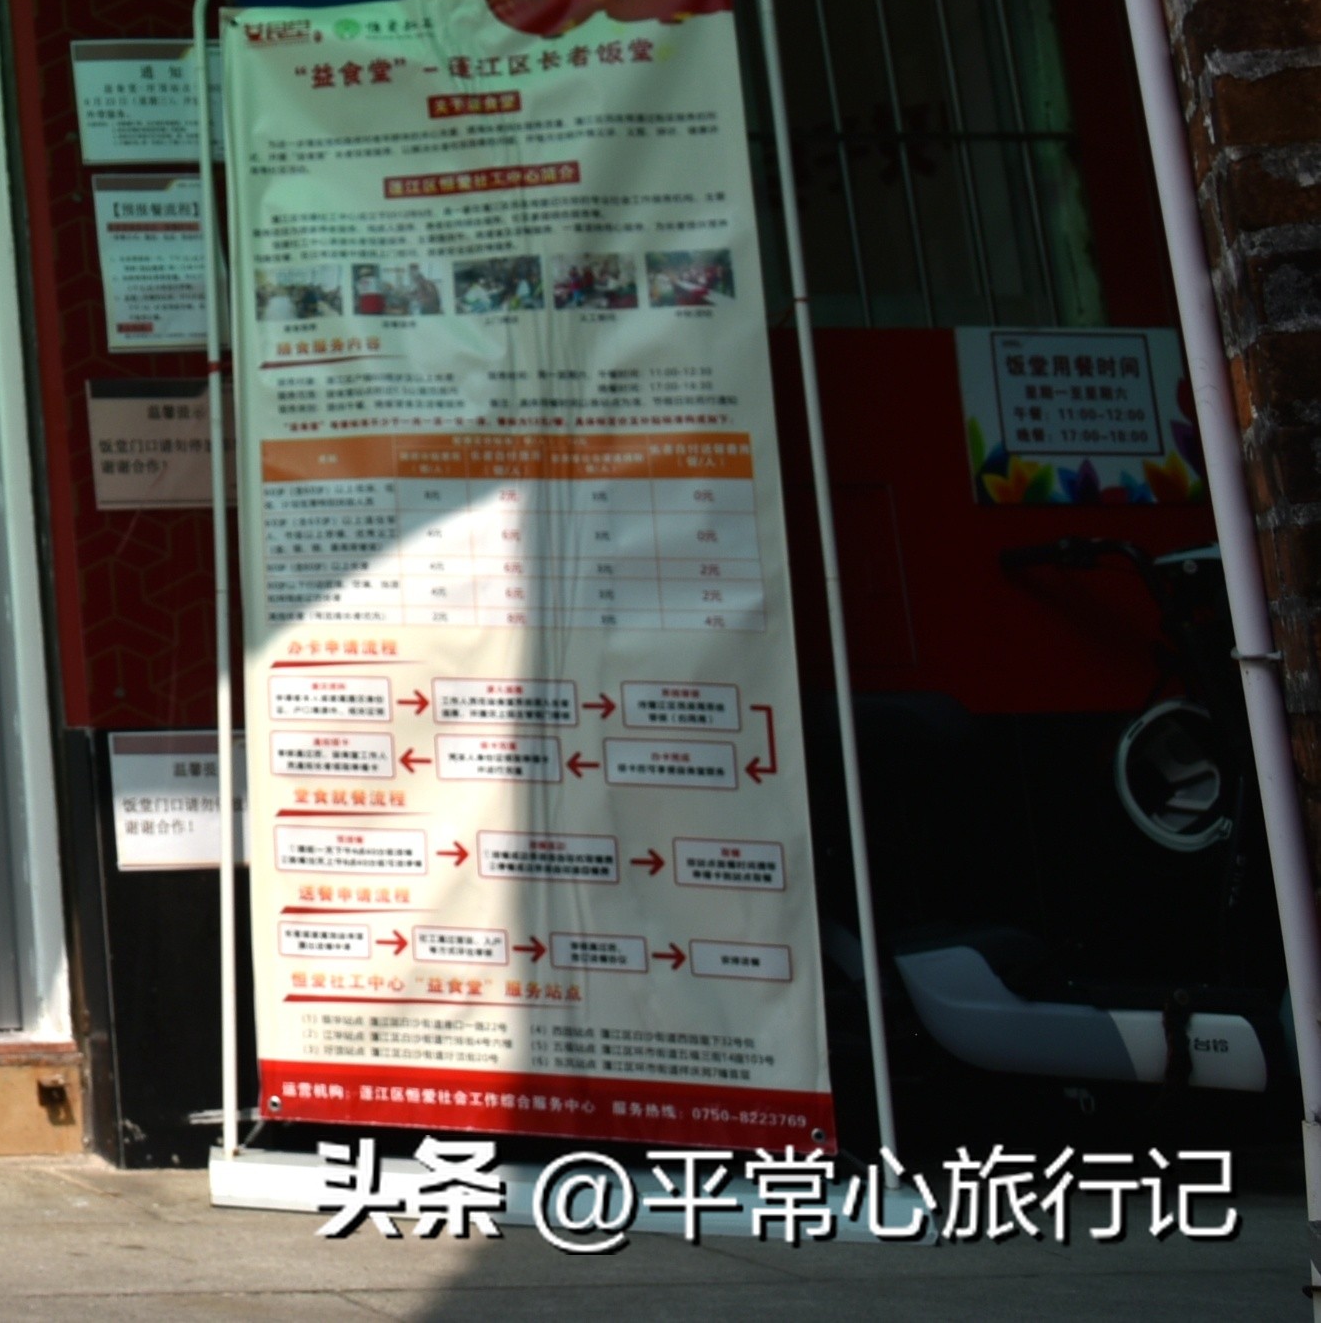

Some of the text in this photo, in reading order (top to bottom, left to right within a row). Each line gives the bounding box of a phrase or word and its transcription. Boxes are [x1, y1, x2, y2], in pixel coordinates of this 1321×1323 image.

[1005, 354, 1140, 379] 饭堂用餐时间
[1025, 385, 1128, 401] 星期一至星期六
[1058, 407, 1145, 422] 11:00-12:00
[1061, 429, 1148, 444] 17:00-18:00
[173, 761, 219, 777] 温馨提
[291, 972, 405, 993] 恒爱社工中心
[359, 1083, 597, 1115] 蓬江区恒爱社会工作综合服务中心
[691, 1107, 808, 1128] 0750-8223769
